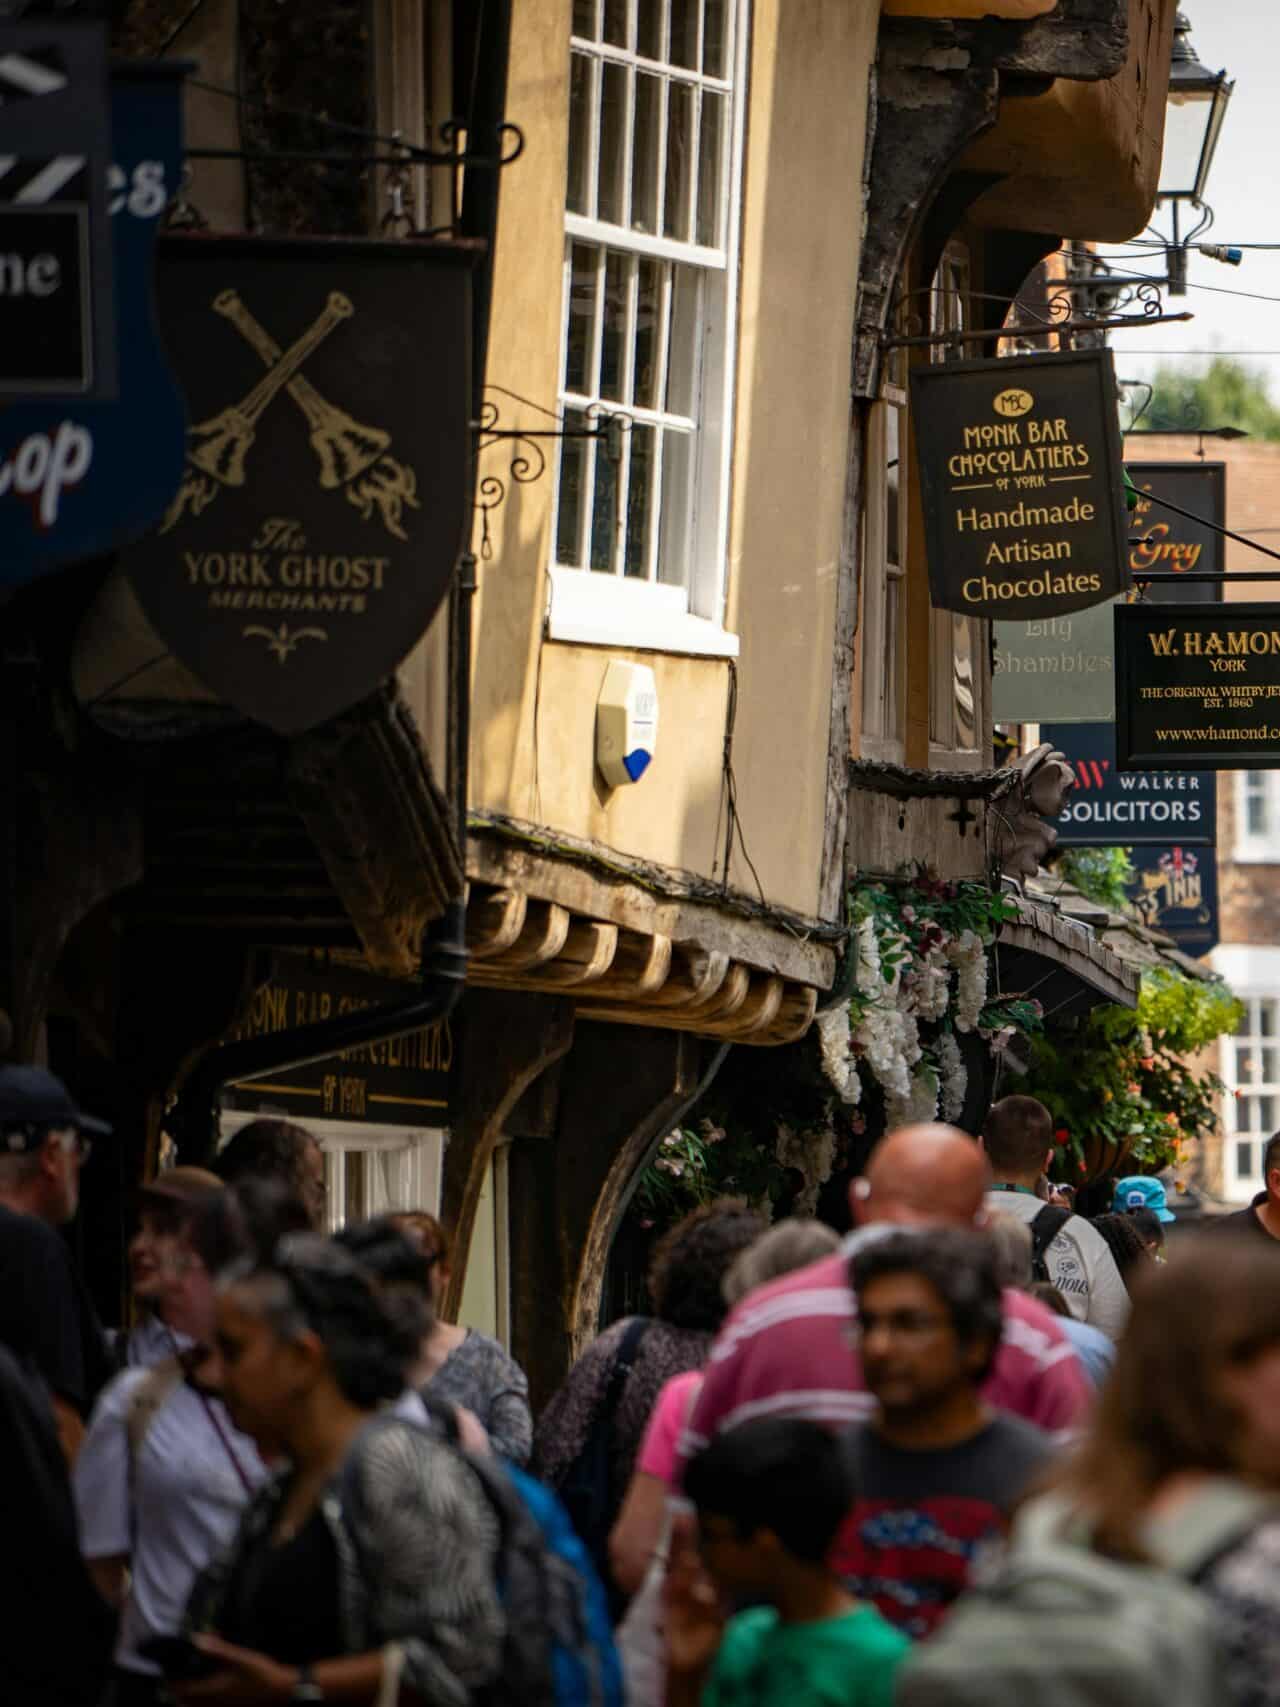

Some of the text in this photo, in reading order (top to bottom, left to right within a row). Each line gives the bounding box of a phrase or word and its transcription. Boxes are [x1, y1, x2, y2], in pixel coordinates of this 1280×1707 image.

[964, 418, 1068, 449] MONK BAR
[949, 444, 1089, 476] CHOCOLATIERS
[1015, 474, 1046, 488] YORK
[957, 497, 1096, 531] Handmade
[251, 515, 306, 551] The
[986, 539, 1072, 565] Artisan
[1129, 522, 1203, 573] Grey
[184, 550, 391, 591] YORK GHOST
[962, 571, 1101, 602] Chocolates
[208, 590, 368, 615] MERCHANTS
[1149, 628, 1179, 656] W.
[994, 650, 1111, 674] Shambles
[1210, 658, 1247, 672] YORK
[1140, 687, 1163, 698] THE
[1164, 686, 1219, 697] ORIGINAL
[1221, 686, 1266, 697] WHITBY
[1203, 698, 1254, 708] EST. 1860
[1120, 776, 1200, 790] WALKER
[1059, 800, 1201, 822] SOLICITORS
